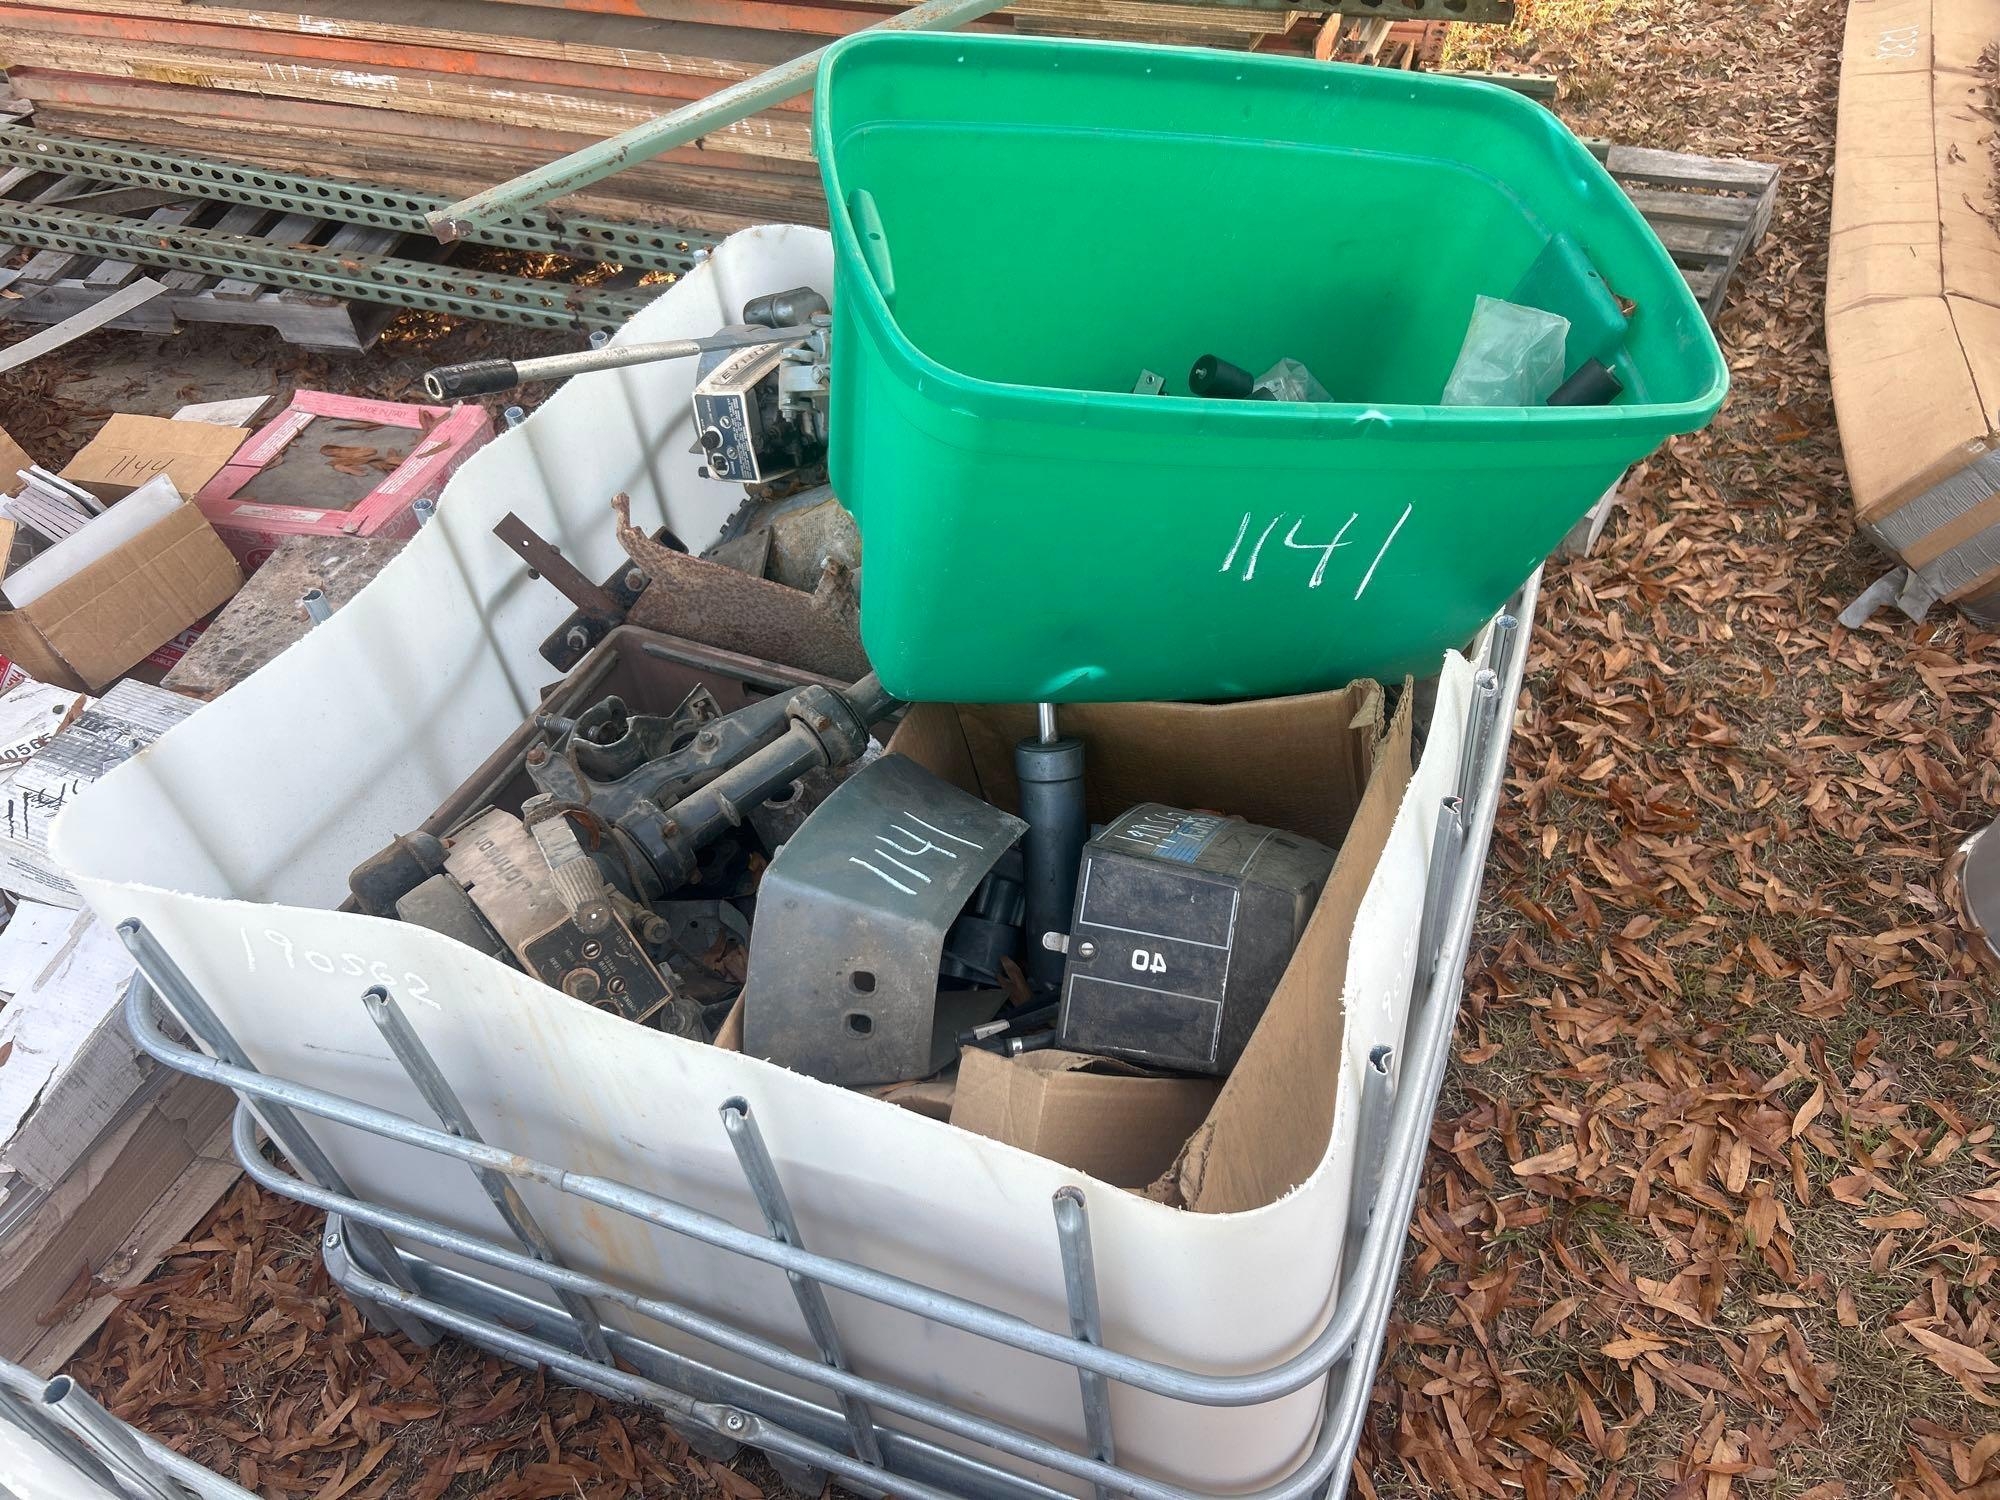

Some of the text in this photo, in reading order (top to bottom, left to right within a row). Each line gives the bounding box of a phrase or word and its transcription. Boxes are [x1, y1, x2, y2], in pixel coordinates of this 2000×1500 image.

[104, 454, 175, 480] 1144
[1218, 500, 1416, 601] 1141
[848, 811, 984, 896] 1141
[238, 926, 442, 1011] 190562
[1131, 949, 1167, 974] 40
